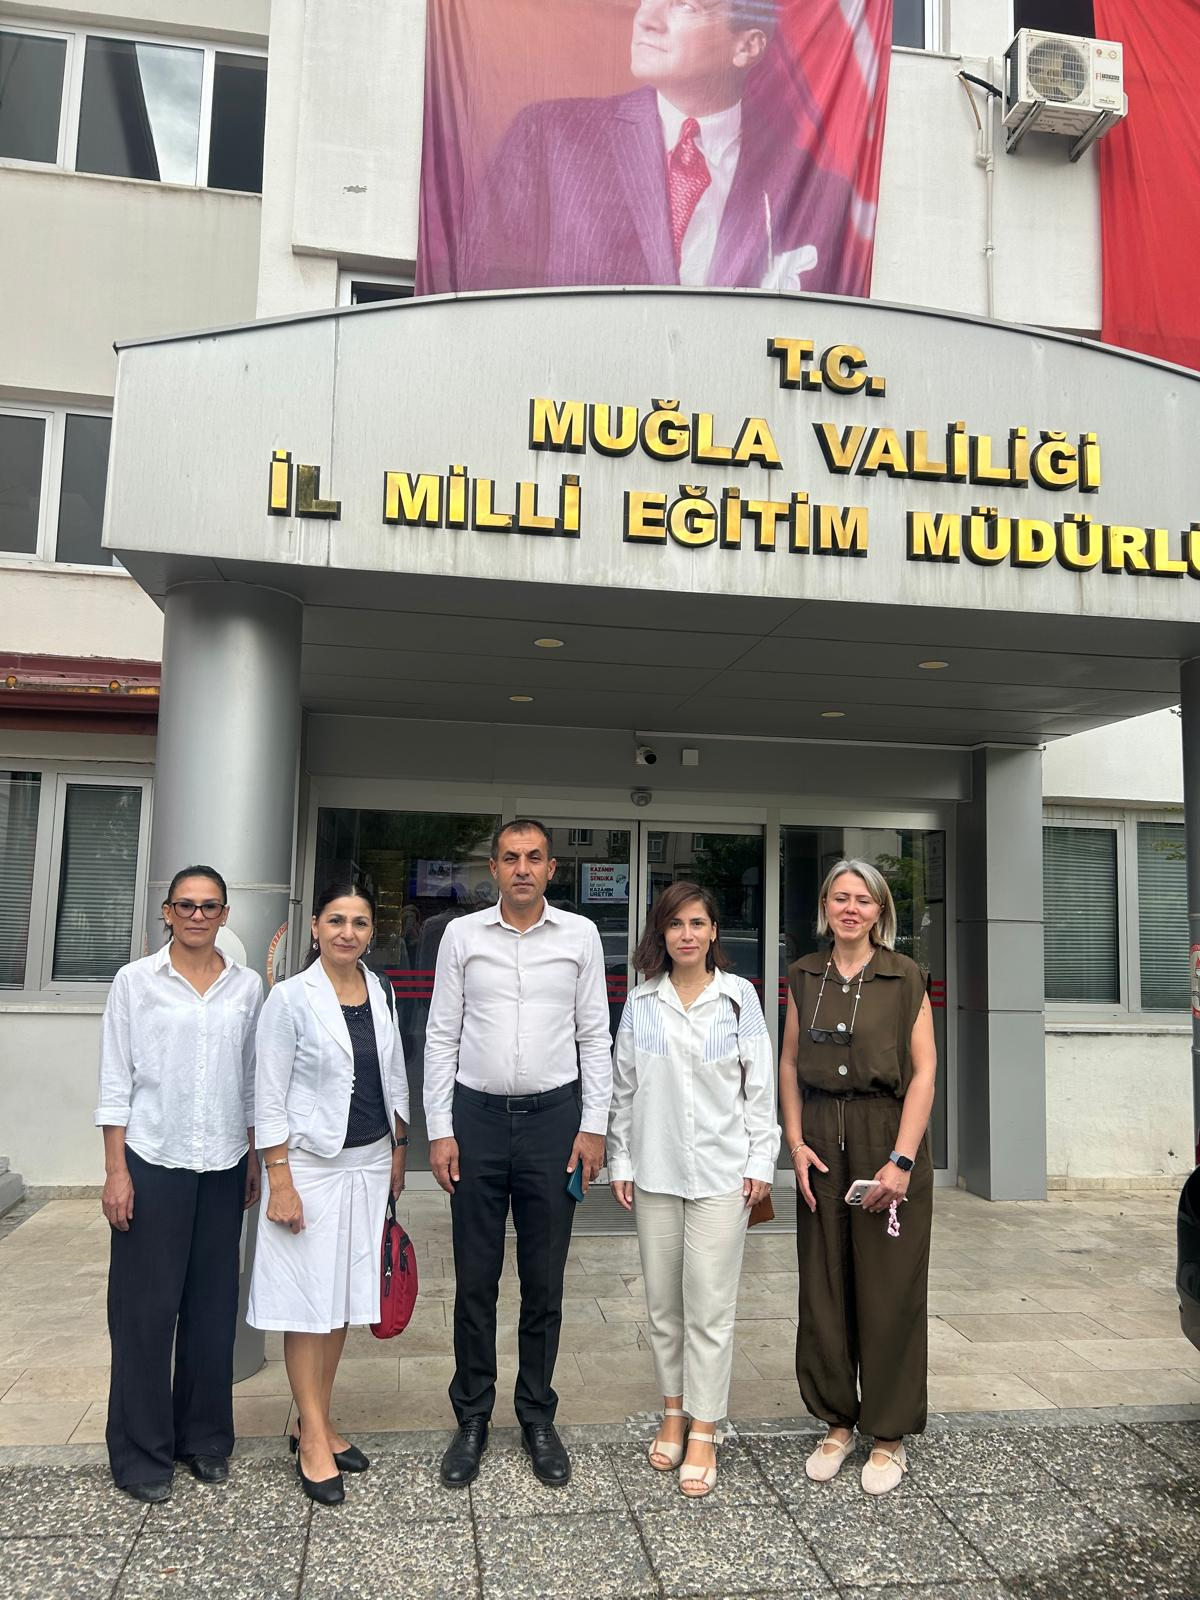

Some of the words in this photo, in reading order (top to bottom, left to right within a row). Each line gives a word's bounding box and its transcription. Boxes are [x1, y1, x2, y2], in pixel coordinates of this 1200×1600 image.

[767, 337, 885, 397] T.C.
[529, 398, 783, 470] MUĞLA
[812, 421, 1101, 493] VALİLİĞİ
[268, 449, 341, 521] İL
[383, 465, 581, 538] MİLLİ
[623, 484, 869, 558] EĞİTİM
[906, 506, 1200, 580] MÜDÜRL
